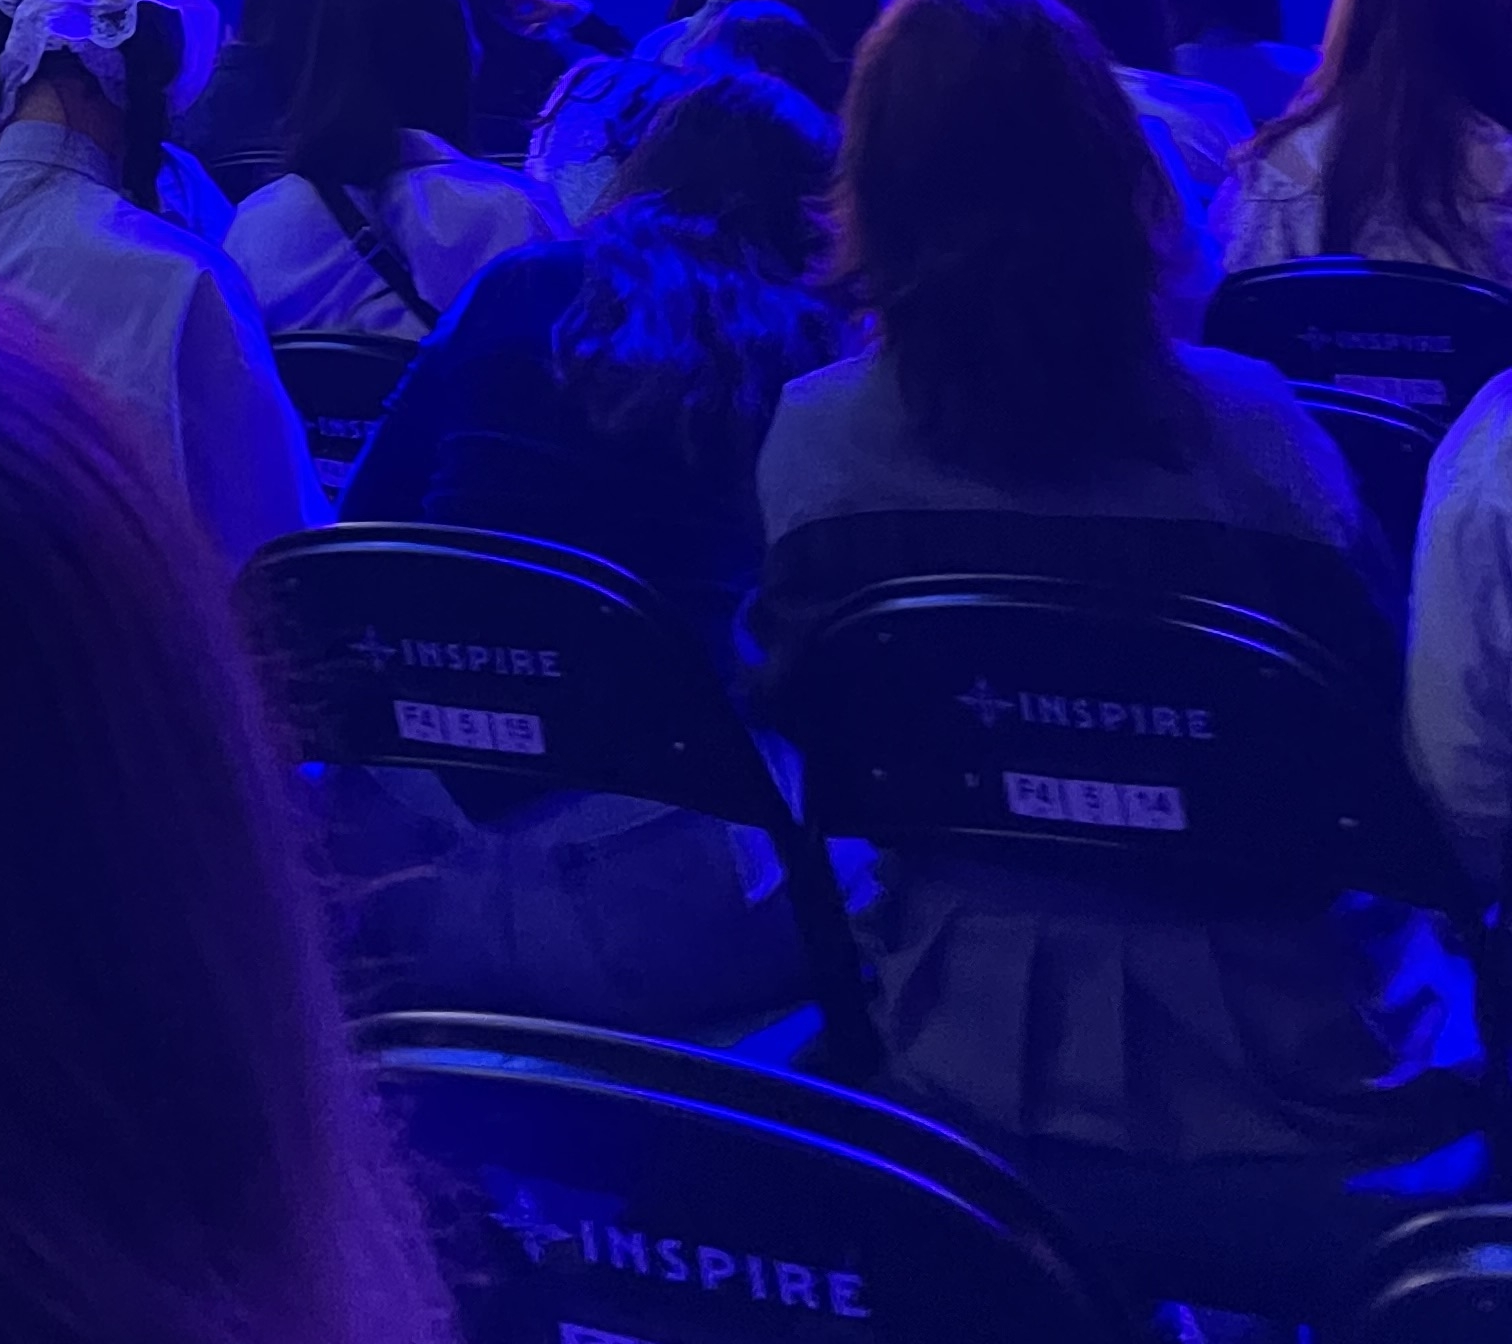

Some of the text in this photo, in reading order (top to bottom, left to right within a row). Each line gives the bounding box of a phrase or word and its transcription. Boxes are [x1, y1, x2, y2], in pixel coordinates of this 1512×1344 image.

[400, 638, 561, 678] INSPIRE
[1017, 690, 1217, 740] INSPIRE
[579, 1218, 872, 1320] INSPIRE
